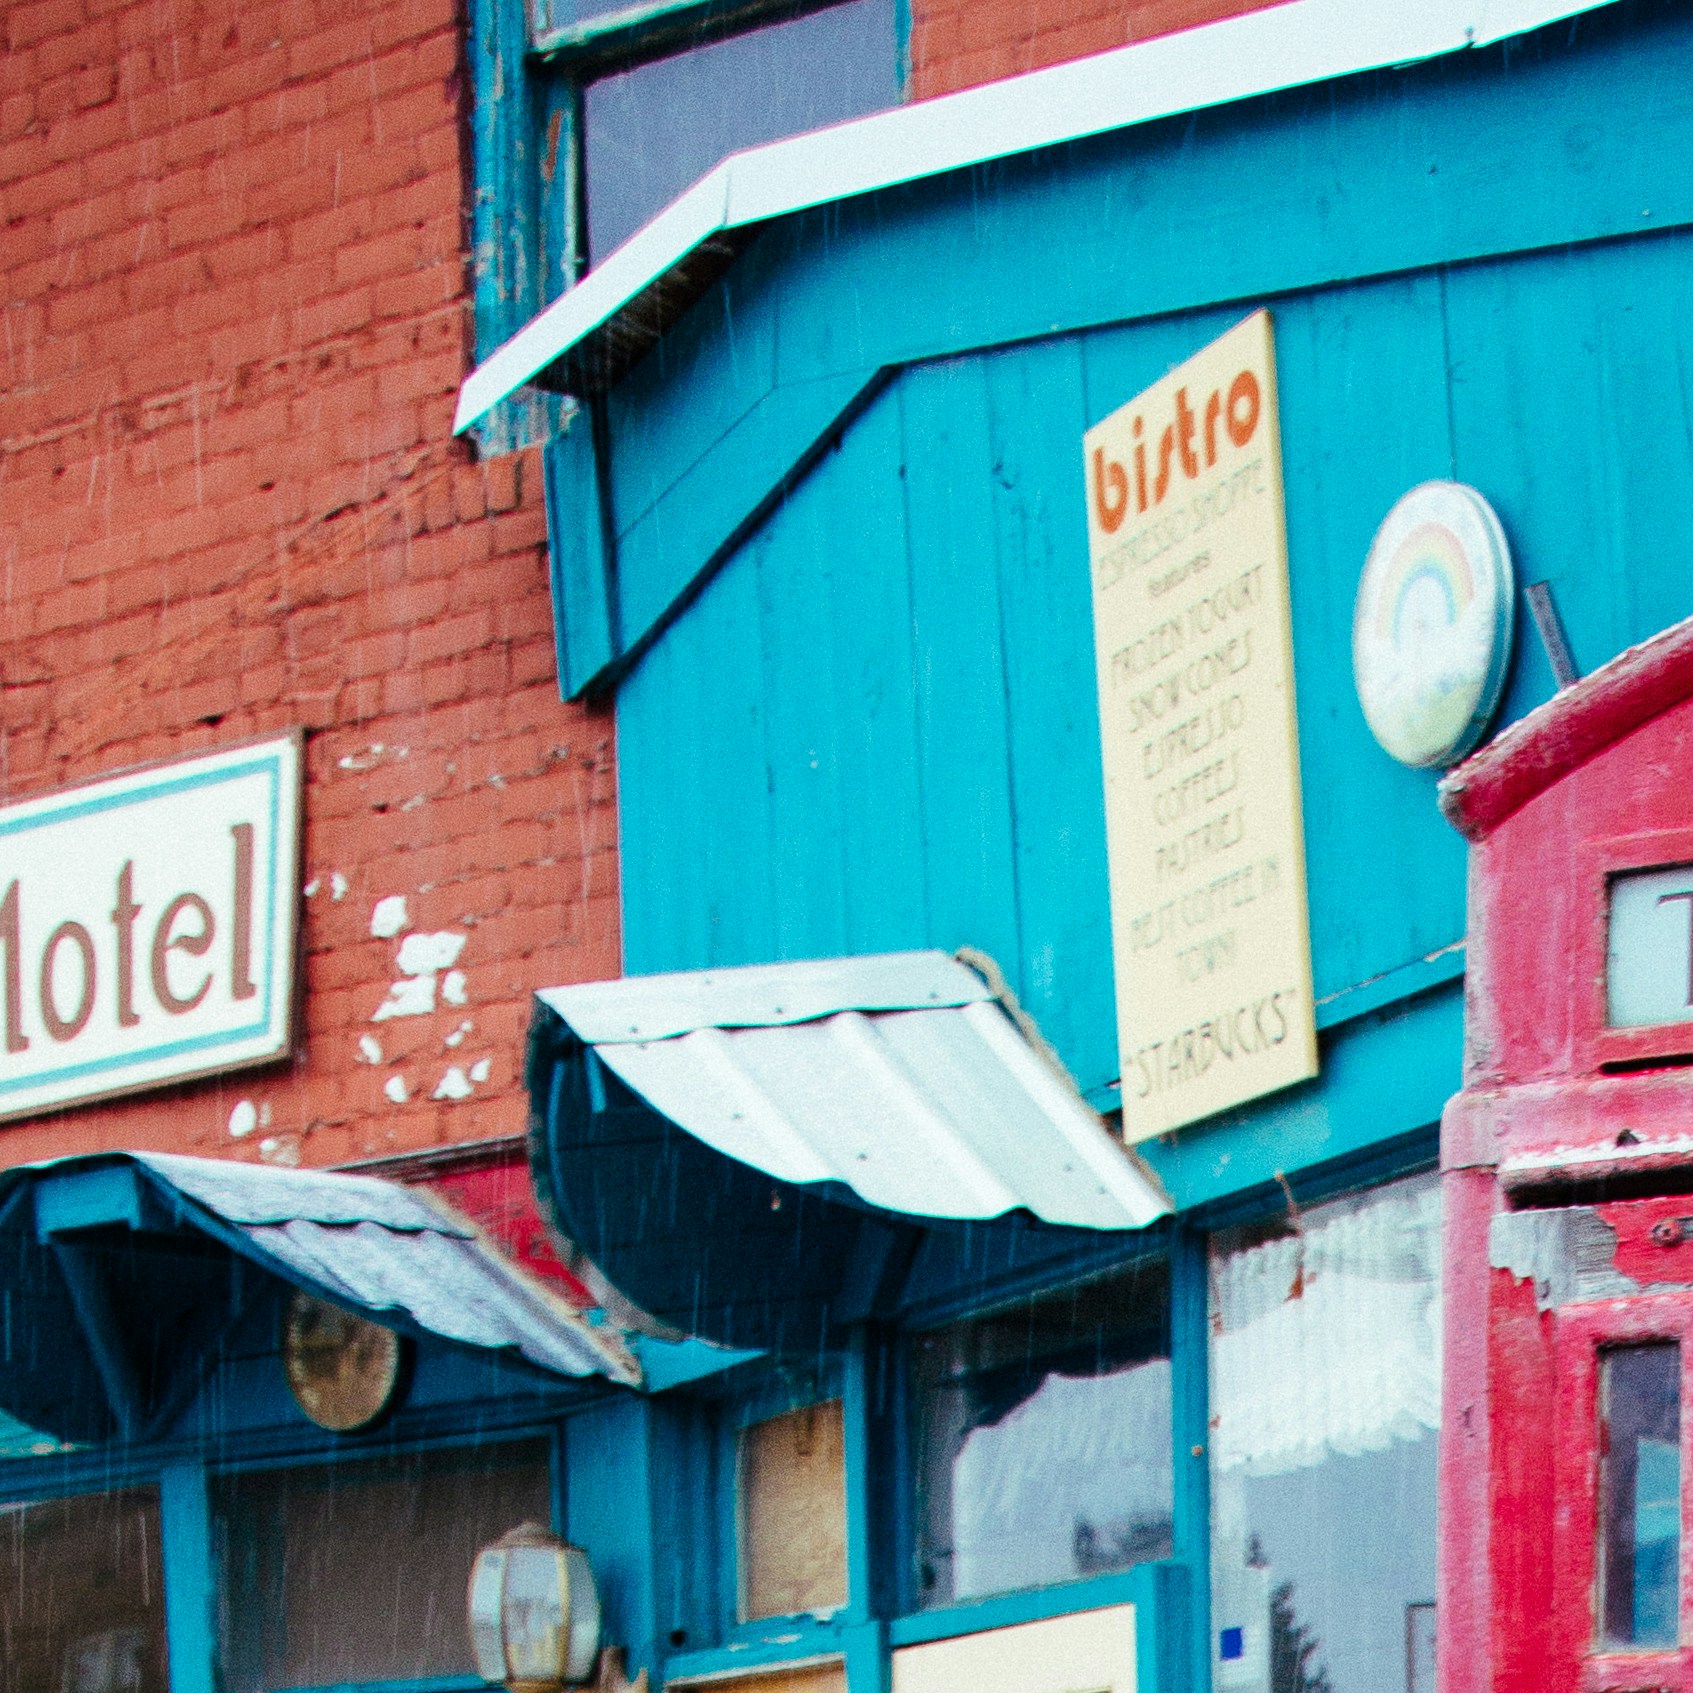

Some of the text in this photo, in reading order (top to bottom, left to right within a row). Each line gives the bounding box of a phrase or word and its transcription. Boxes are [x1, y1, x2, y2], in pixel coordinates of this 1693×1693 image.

[1092, 368, 1262, 535] bistro
[1111, 562, 1267, 689] FROZEN YOGURT
[1129, 628, 1254, 734] SNOW CONES
[1143, 692, 1245, 780] ESPRESSO
[1153, 750, 1240, 827] COFFEES
[1154, 804, 1245, 884] PASTRIES
